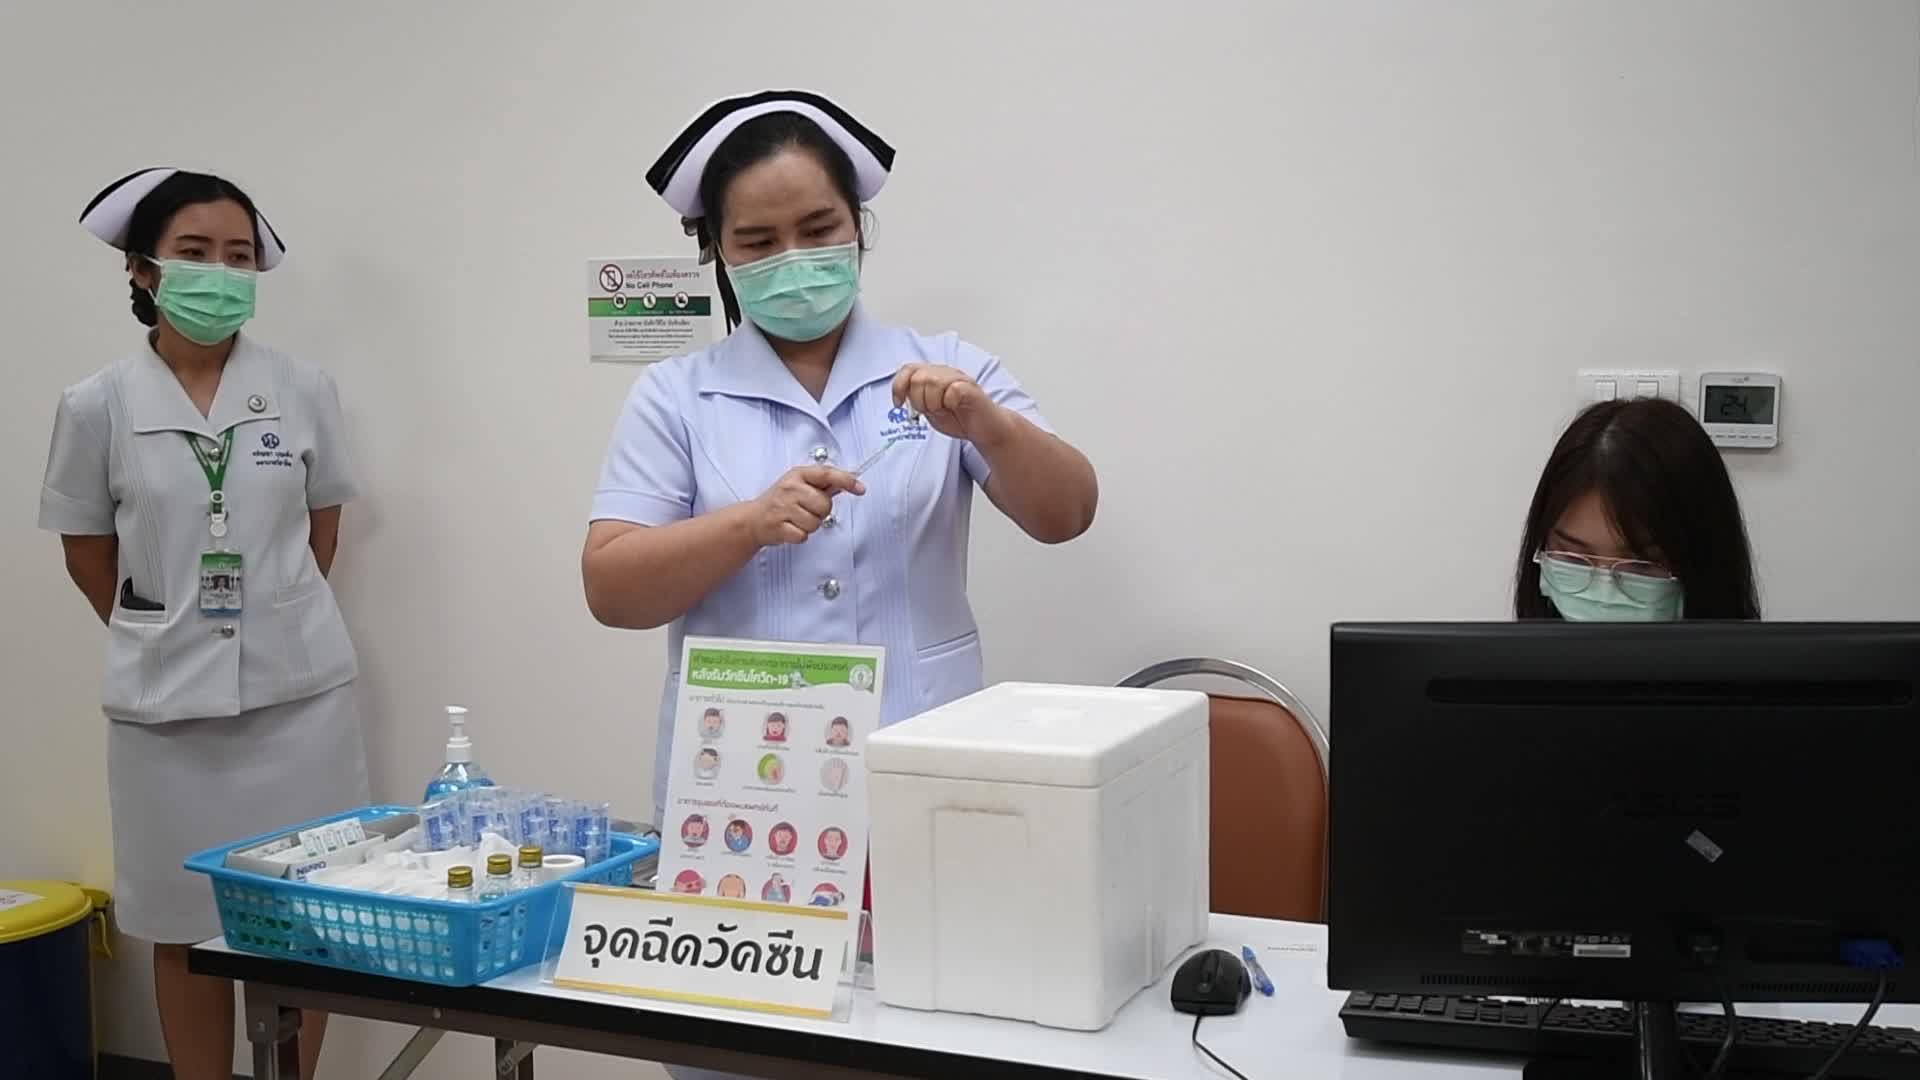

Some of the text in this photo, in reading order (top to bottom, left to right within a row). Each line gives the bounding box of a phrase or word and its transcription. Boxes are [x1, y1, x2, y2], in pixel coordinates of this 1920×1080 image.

[637, 281, 650, 289] Cell
[651, 281, 673, 289] Phone
[1720, 394, 1747, 417] 24
[691, 668, 789, 686] หลังรับวัคซีนโควิด-19
[583, 917, 824, 981] จุดฉีดวัคซีน
